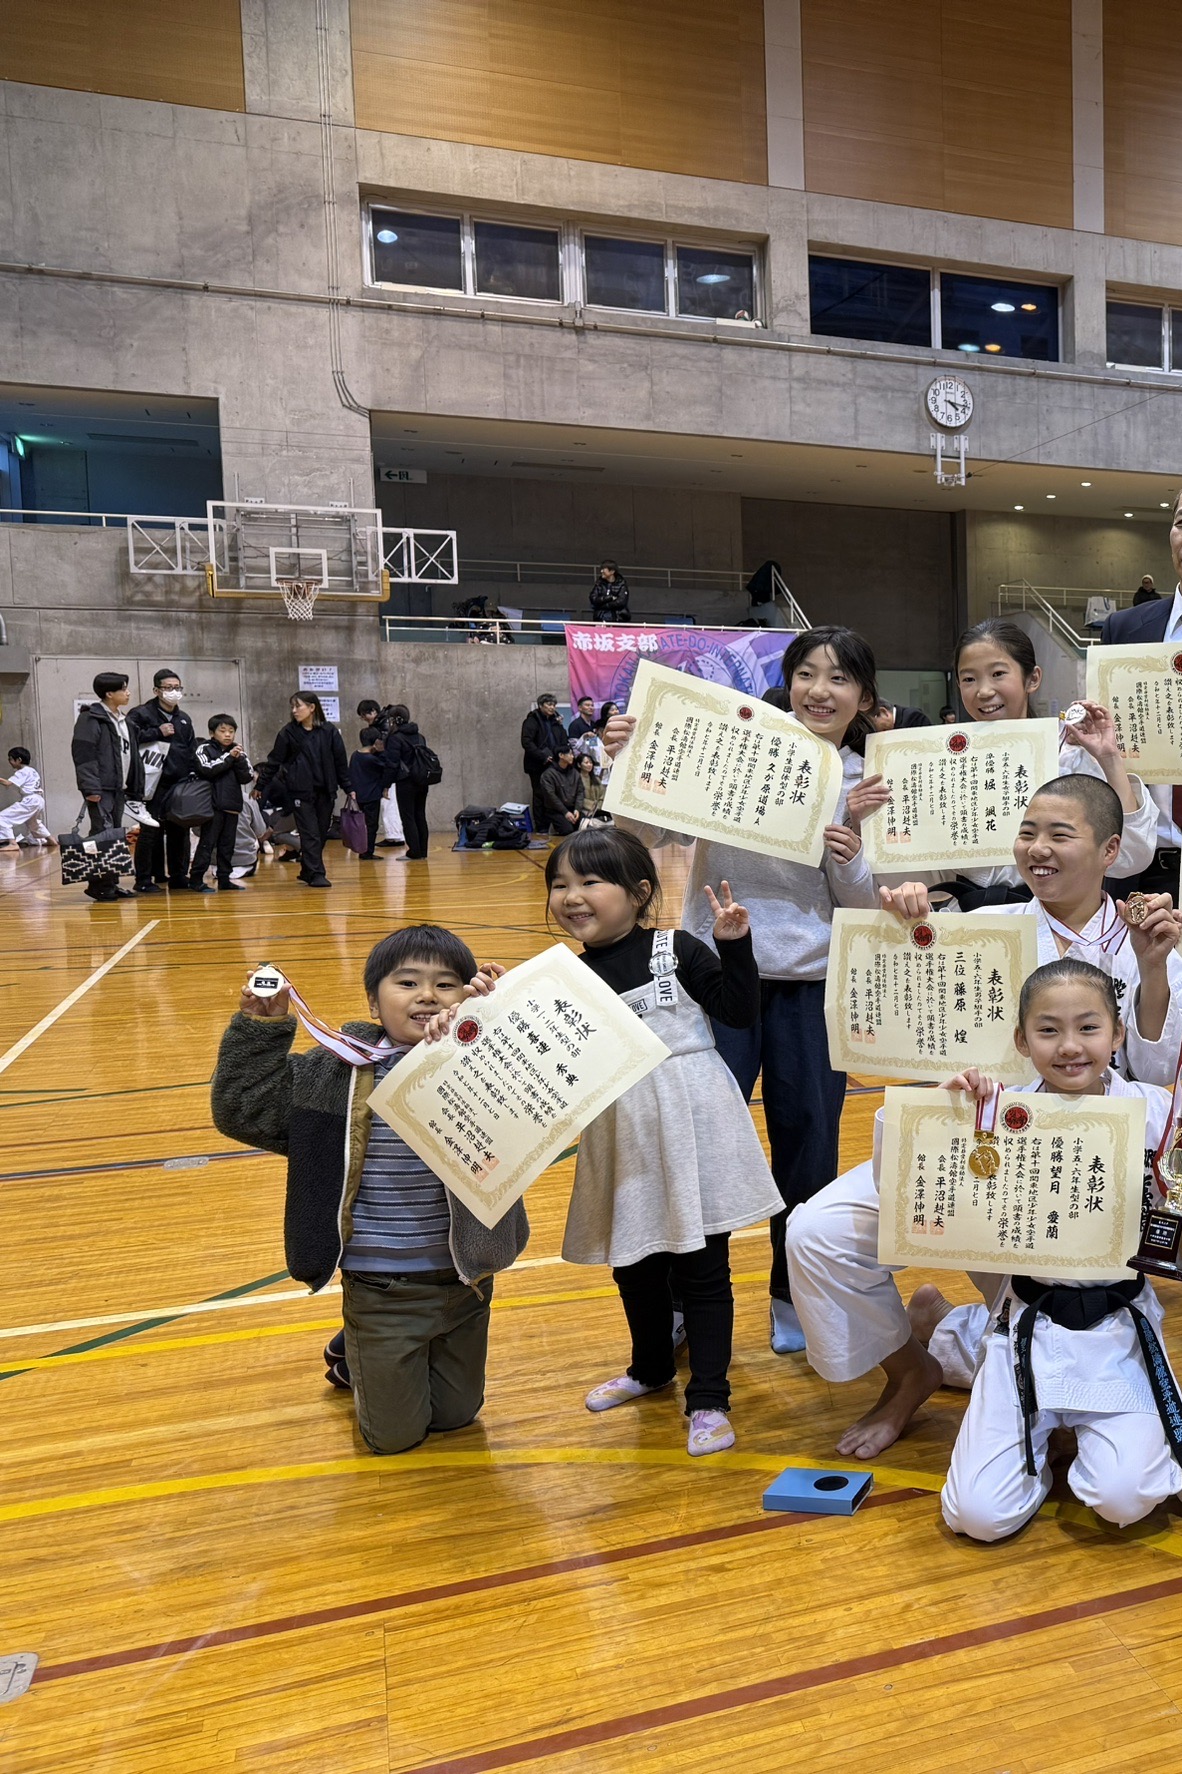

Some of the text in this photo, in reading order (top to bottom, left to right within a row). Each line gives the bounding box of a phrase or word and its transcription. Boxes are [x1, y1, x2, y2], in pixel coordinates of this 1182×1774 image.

[572, 631, 658, 652] 赤坂支部
[790, 760, 812, 805] 表彰状
[1014, 765, 1028, 811] 表彰状
[987, 969, 1004, 1021] 表彰状
[554, 1000, 596, 1040] 表彰状
[937, 1155, 946, 1171] 会長
[1050, 1137, 1064, 1163] 優勝
[1050, 1166, 1062, 1194] 望月
[1084, 1156, 1105, 1212] 表彰状
